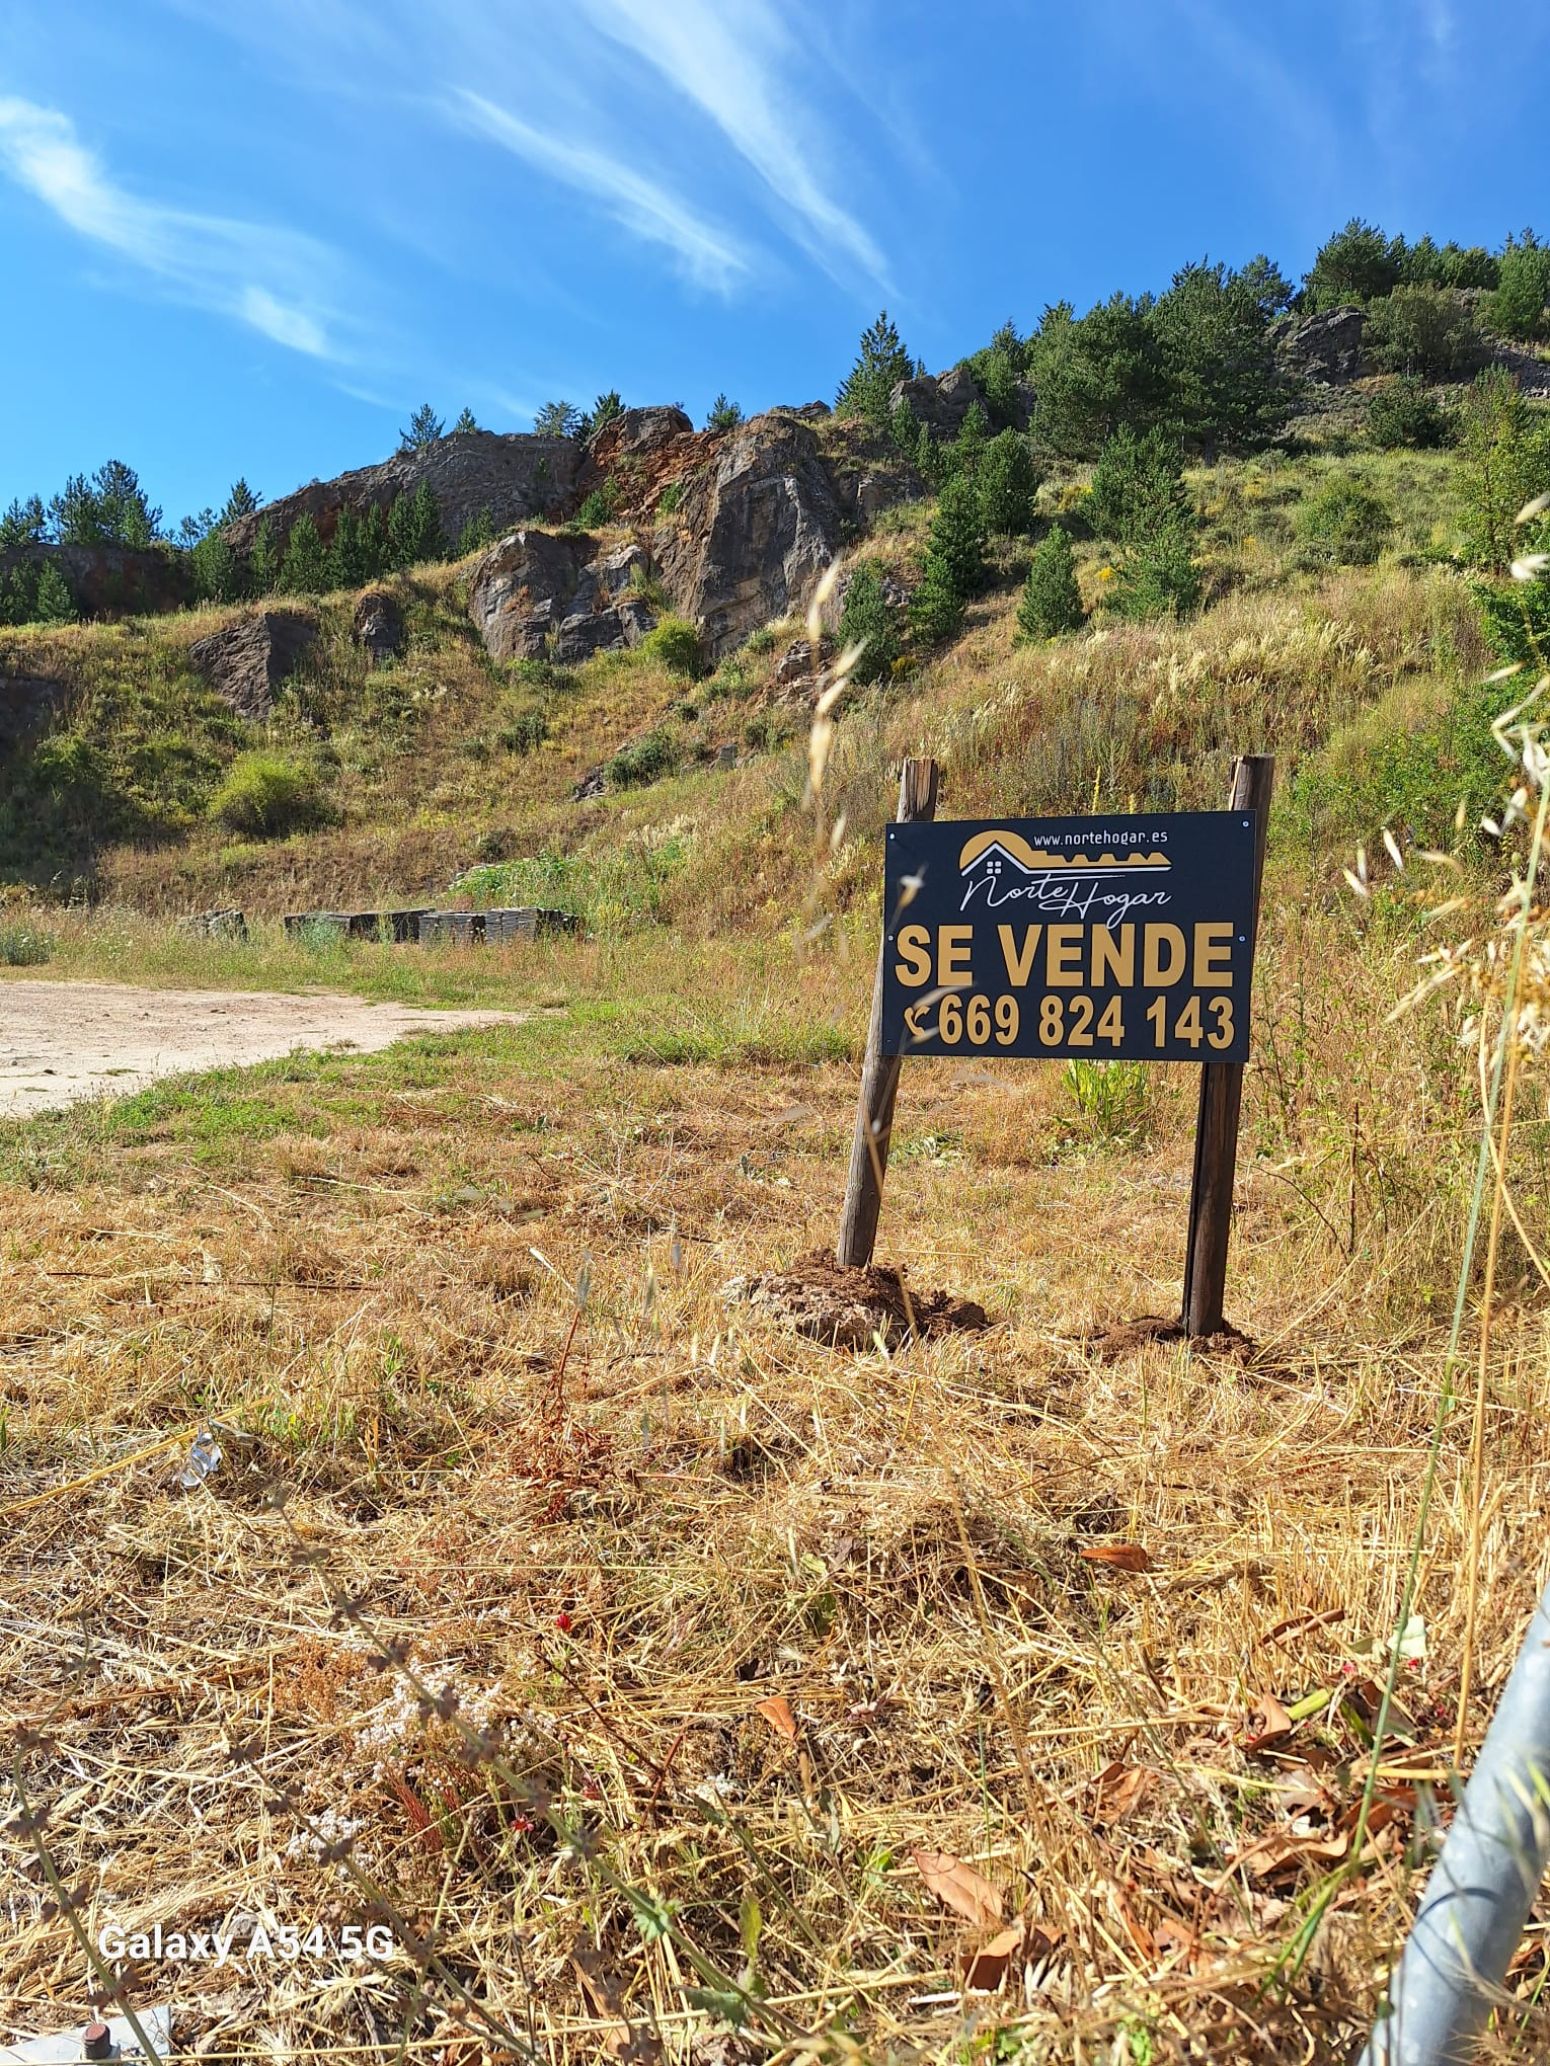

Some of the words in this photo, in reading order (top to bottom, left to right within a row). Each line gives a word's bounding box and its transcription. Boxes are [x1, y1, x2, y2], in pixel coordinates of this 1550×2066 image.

[1034, 830, 1168, 846] www.nortehogar.es
[895, 924, 973, 987] SE
[997, 922, 1234, 988] VENDE
[938, 994, 1020, 1045] 669
[1038, 995, 1125, 1047] 824
[1146, 995, 1235, 1049] 143
